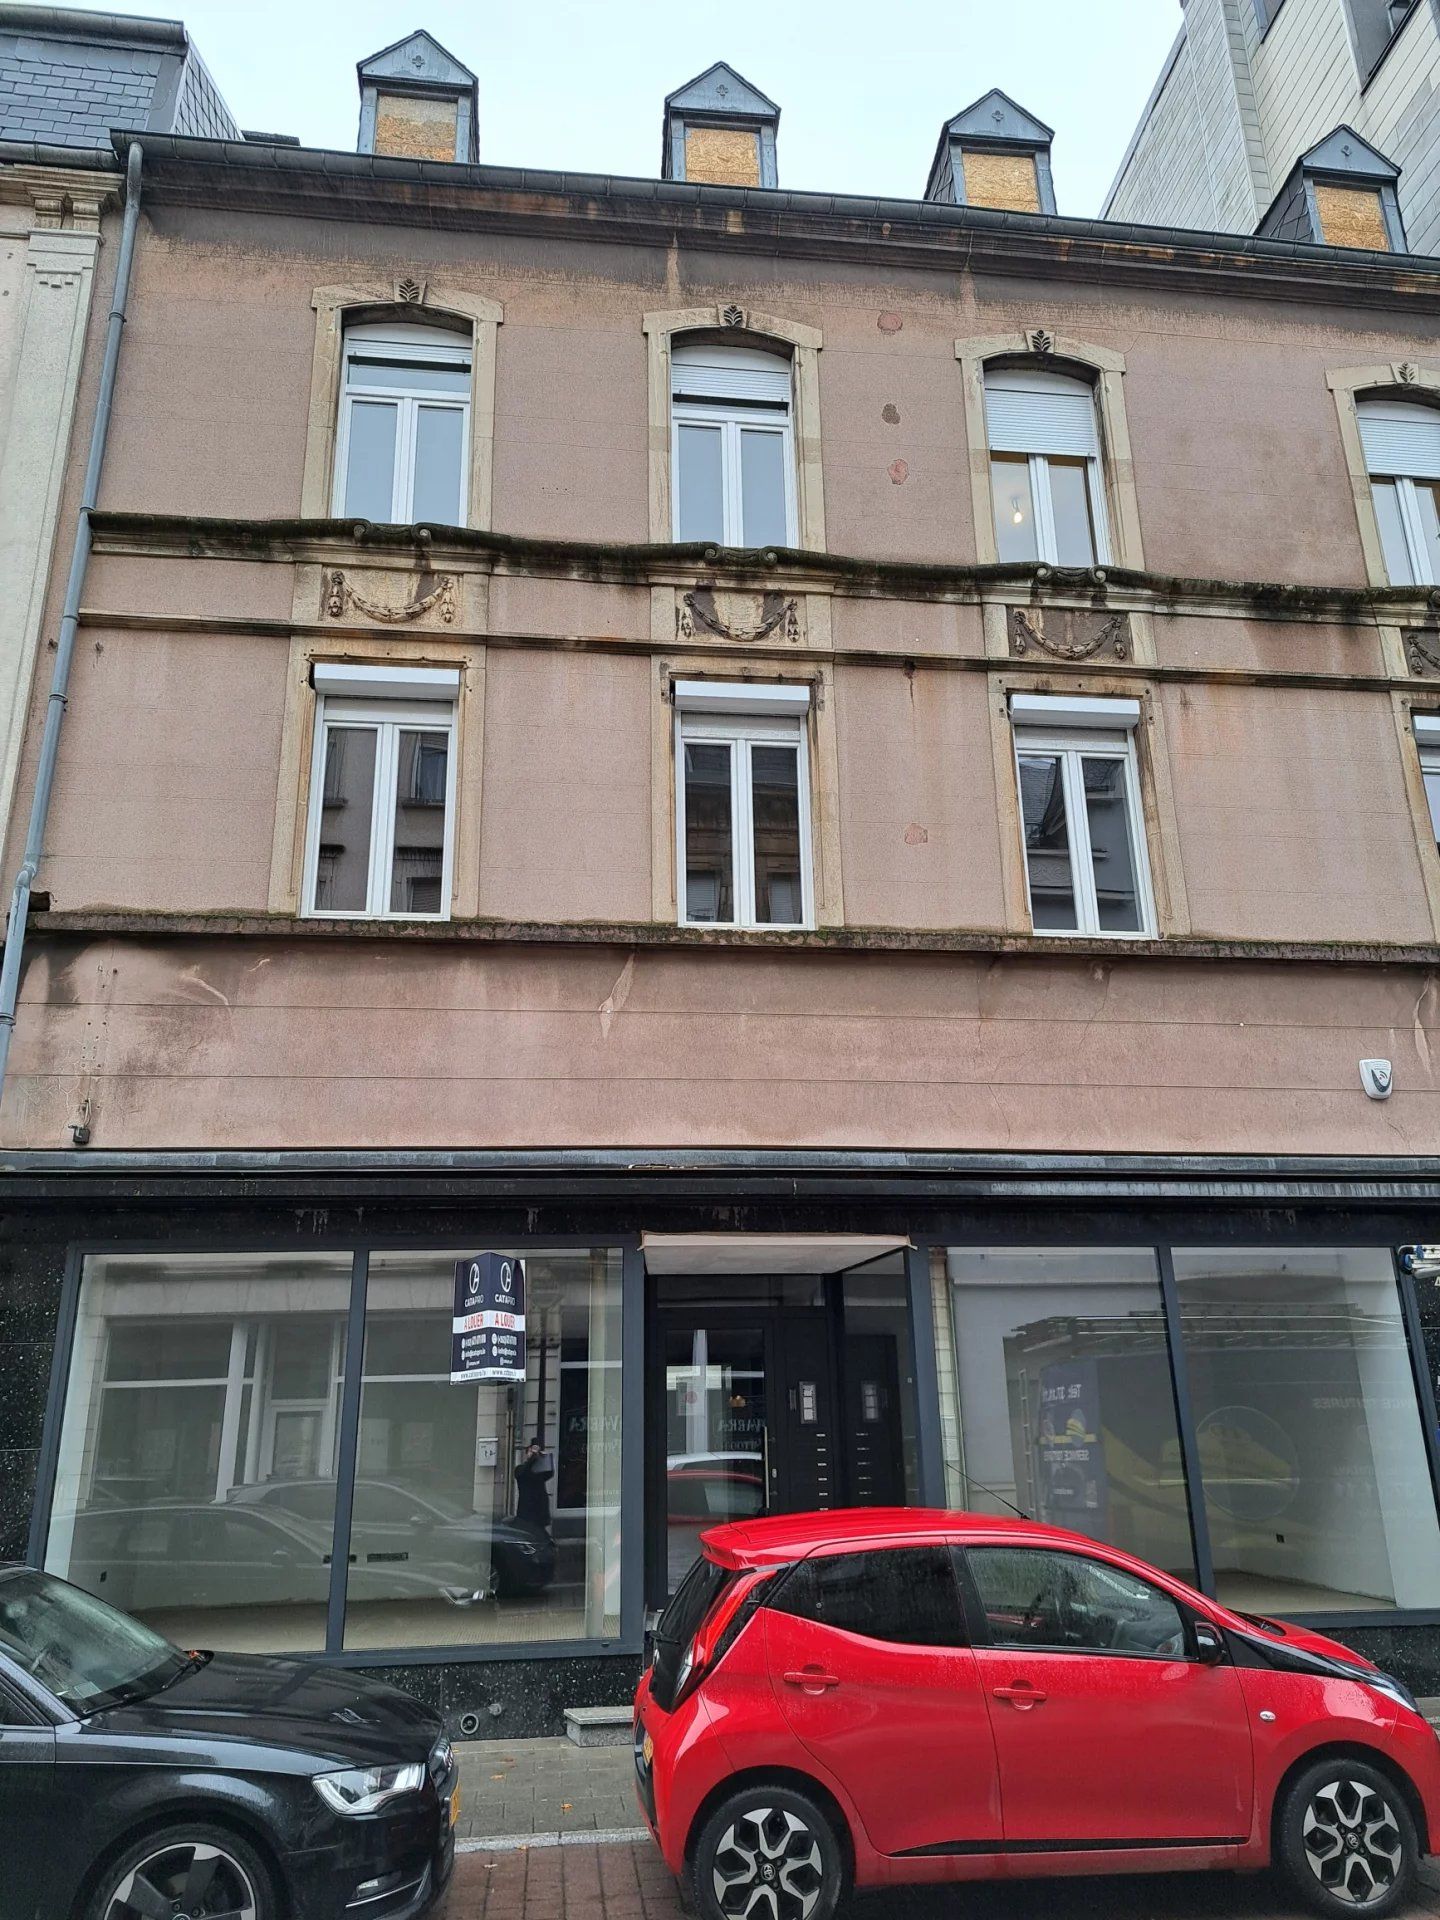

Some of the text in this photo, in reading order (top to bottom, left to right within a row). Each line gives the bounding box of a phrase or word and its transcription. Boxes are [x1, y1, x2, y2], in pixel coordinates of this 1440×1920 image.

[494, 1294, 516, 1306] CATAPRO
[468, 1313, 484, 1330] LOUER
[494, 1313, 516, 1329] A LOUER
